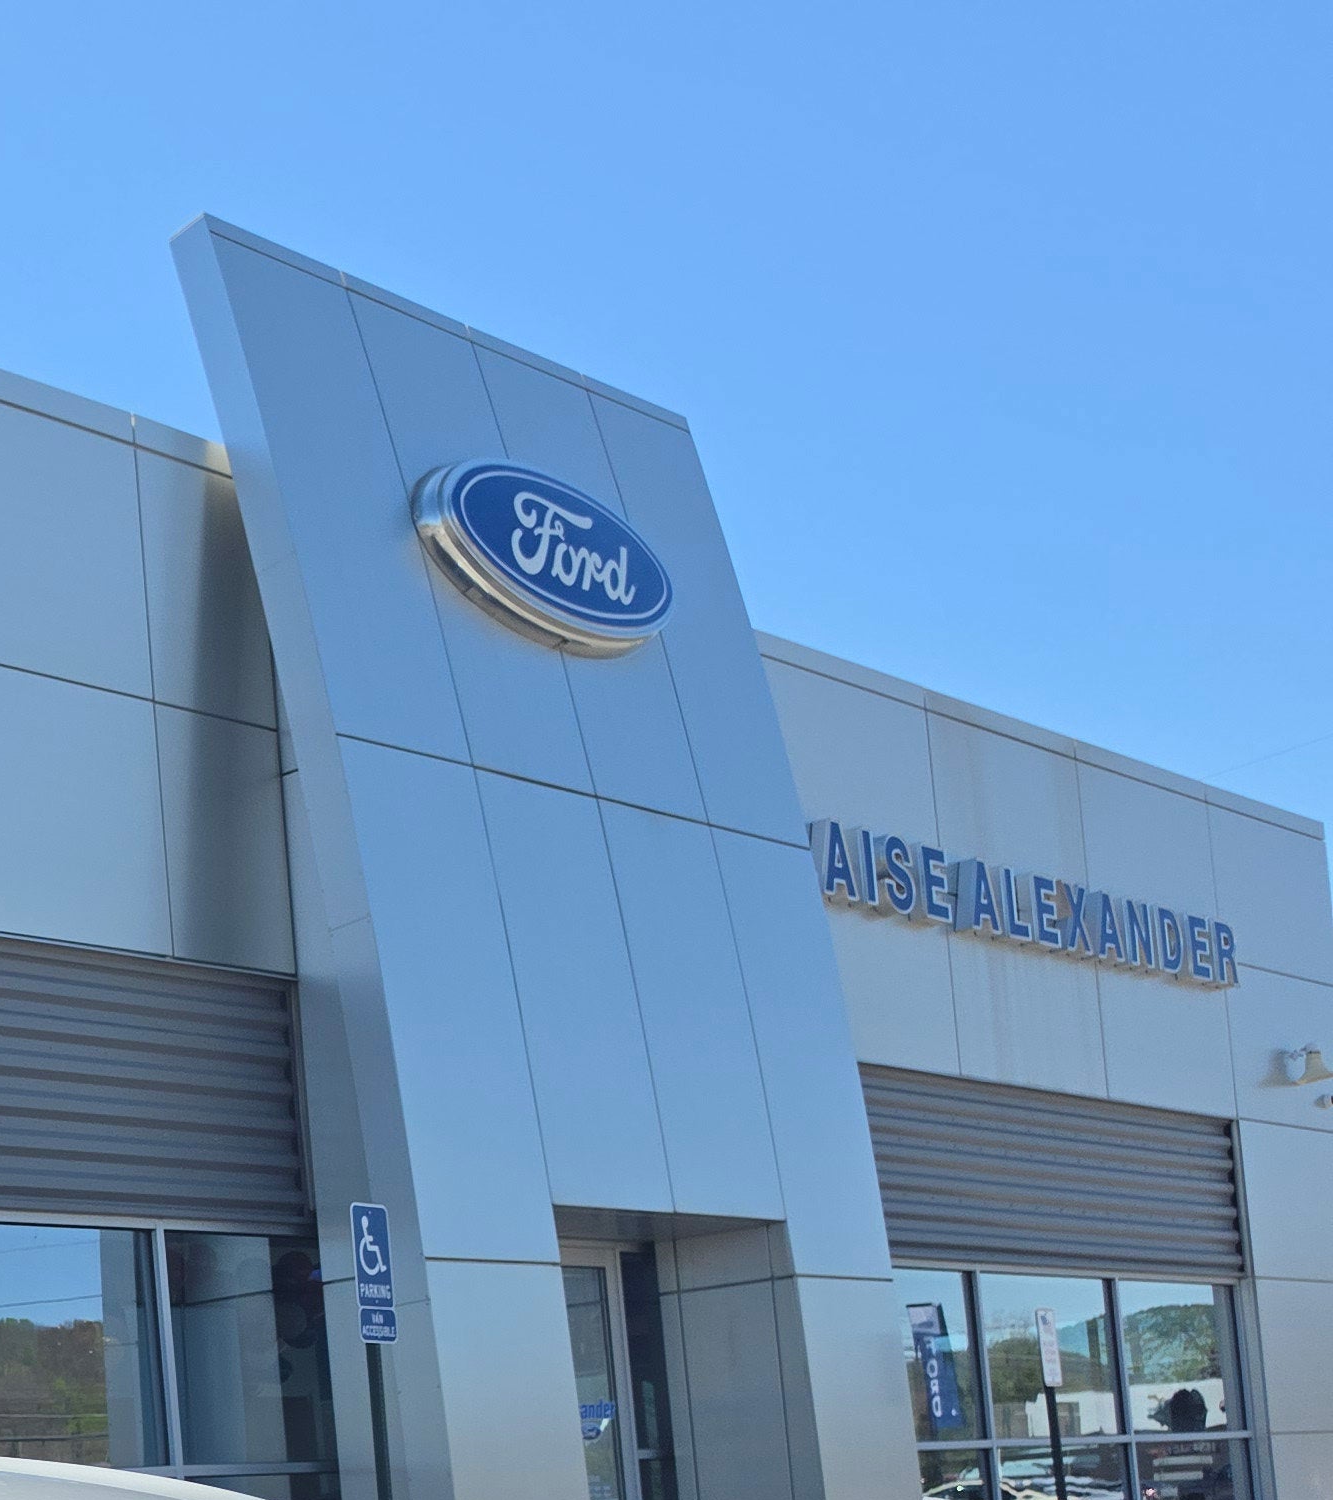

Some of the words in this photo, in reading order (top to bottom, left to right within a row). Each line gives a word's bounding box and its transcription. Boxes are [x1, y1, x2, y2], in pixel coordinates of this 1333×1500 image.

[511, 490, 636, 606] Ford
[971, 857, 1239, 986] ALEXANDER
[359, 1283, 392, 1300] PARKING
